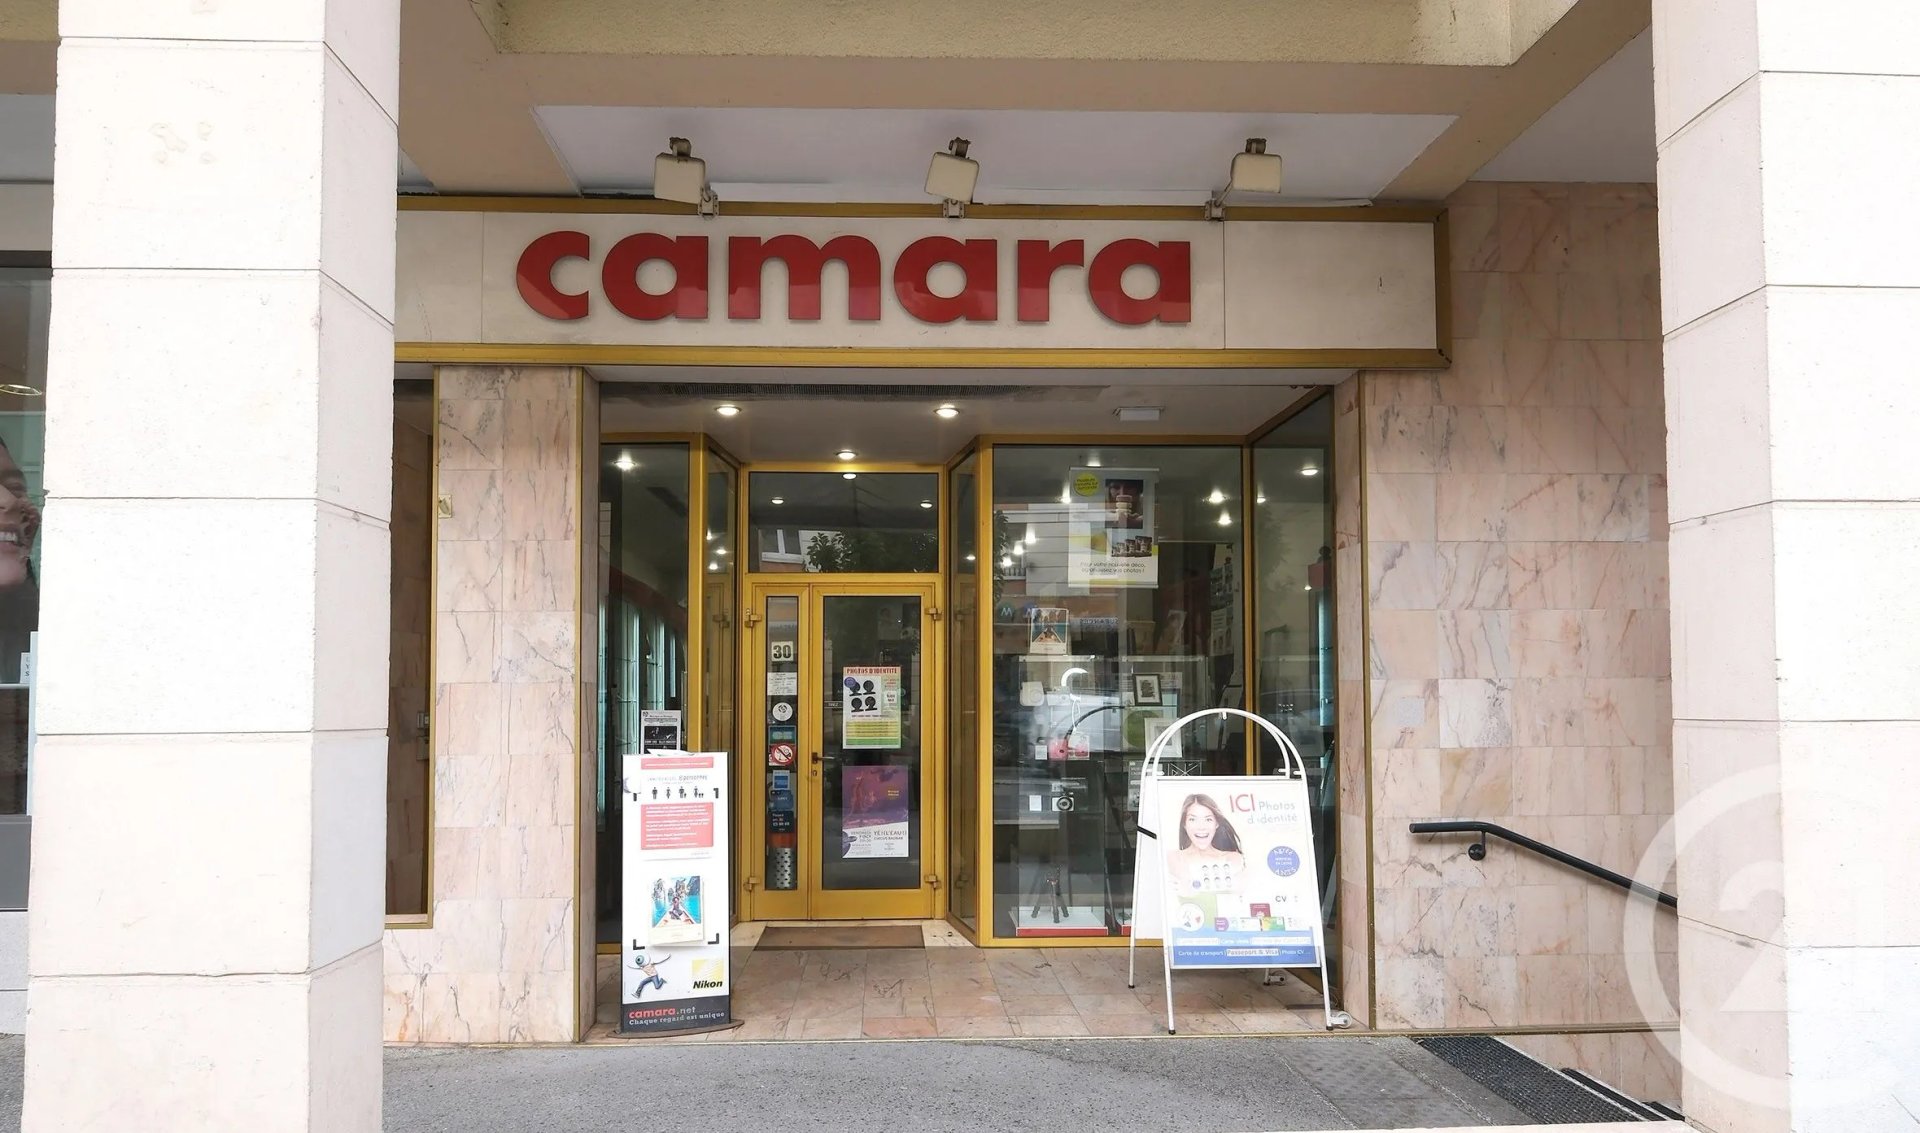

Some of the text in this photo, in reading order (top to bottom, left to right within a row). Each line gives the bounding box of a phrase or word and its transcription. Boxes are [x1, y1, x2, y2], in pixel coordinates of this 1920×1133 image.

[516, 230, 1191, 325] camara
[773, 644, 792, 659] 30
[1229, 793, 1296, 813] ICI Photos
[1227, 949, 1258, 957] Passeport
[692, 980, 723, 989] Nikon
[628, 1006, 697, 1019] camara.net
[629, 1018, 658, 1026] Chaque
[660, 1015, 685, 1024] regard
